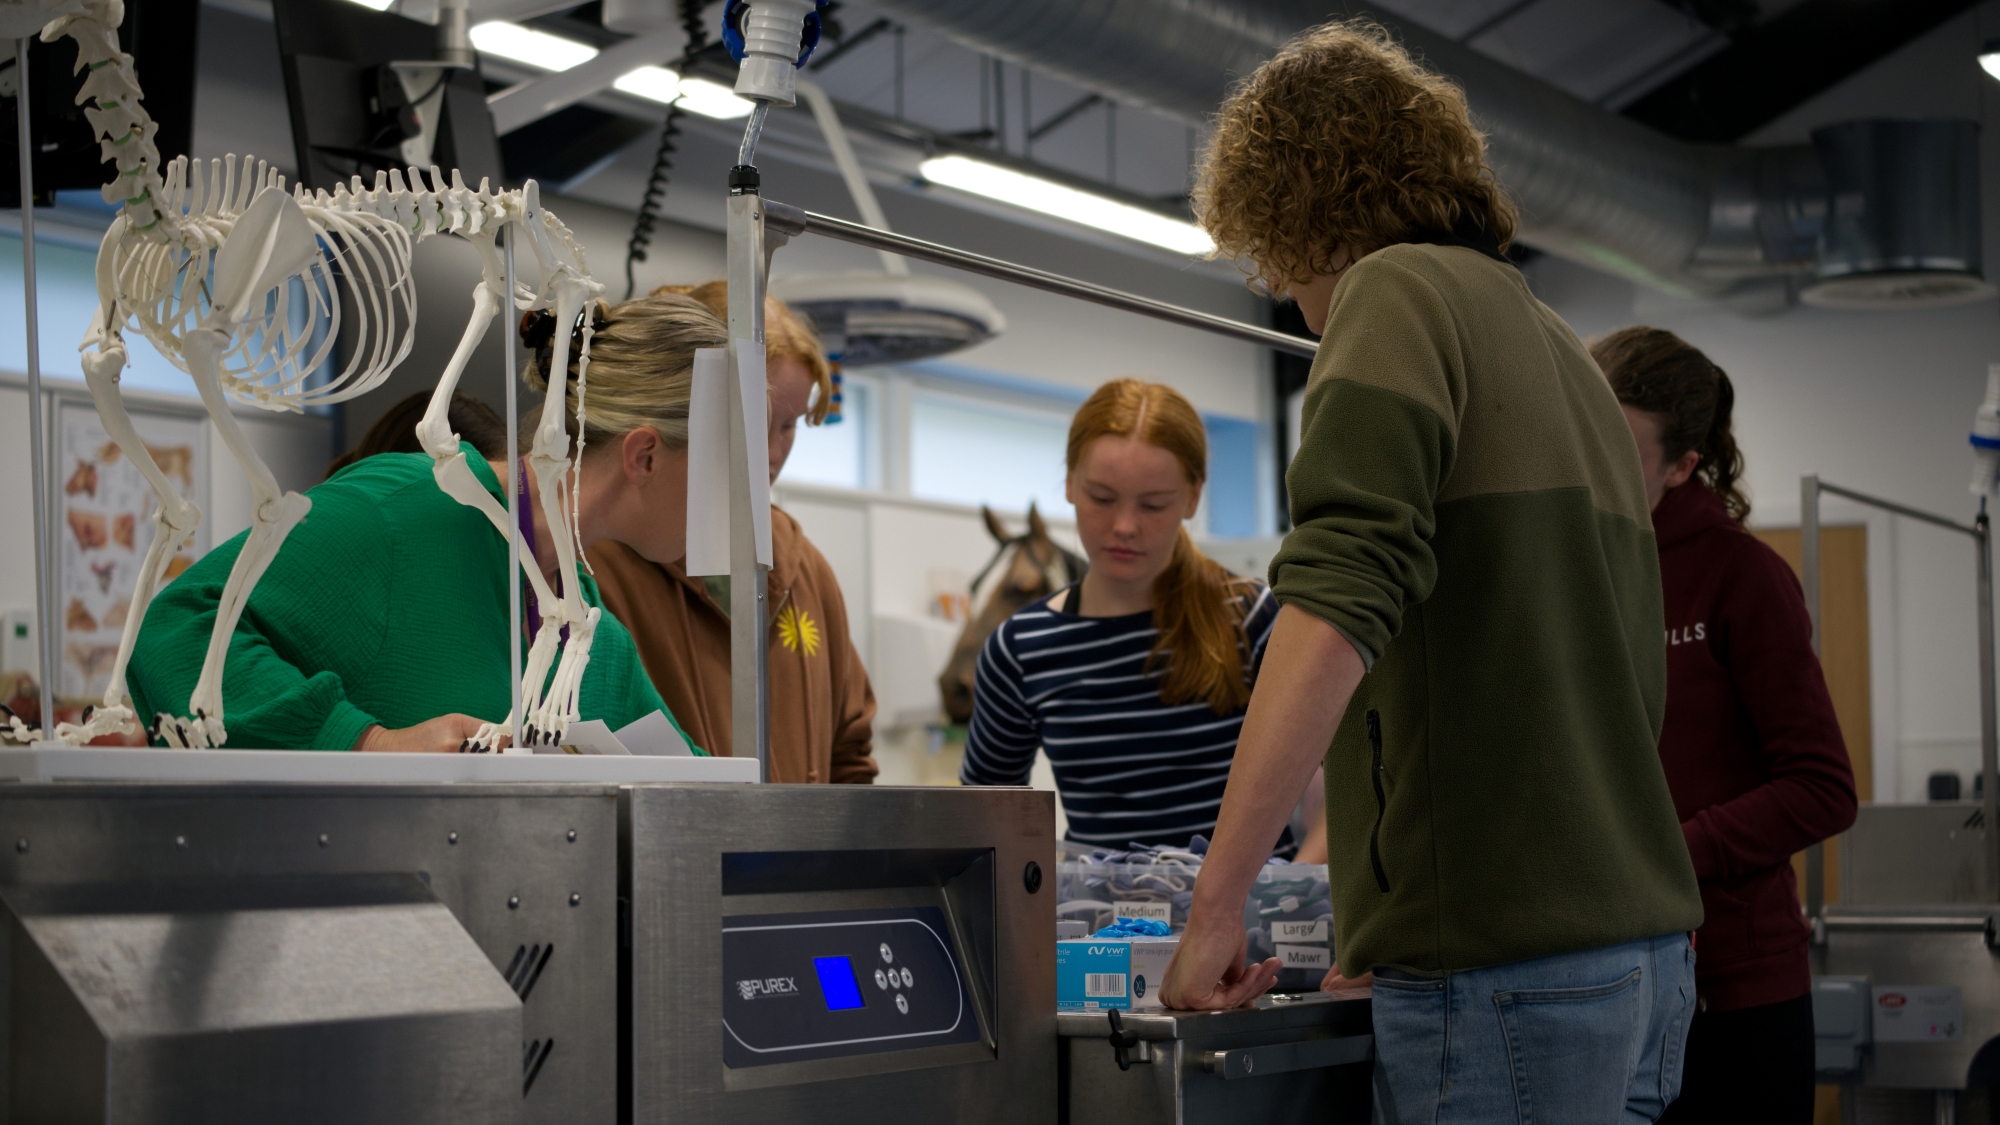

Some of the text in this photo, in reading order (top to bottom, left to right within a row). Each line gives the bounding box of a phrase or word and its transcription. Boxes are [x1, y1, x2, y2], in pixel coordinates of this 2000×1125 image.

[1118, 905, 1165, 917] Medium
[1283, 924, 1314, 937] Large
[1056, 948, 1071, 956] trile
[1288, 952, 1321, 963] Mawr
[750, 977, 799, 994] PUREX
[1135, 980, 1144, 992] XL
